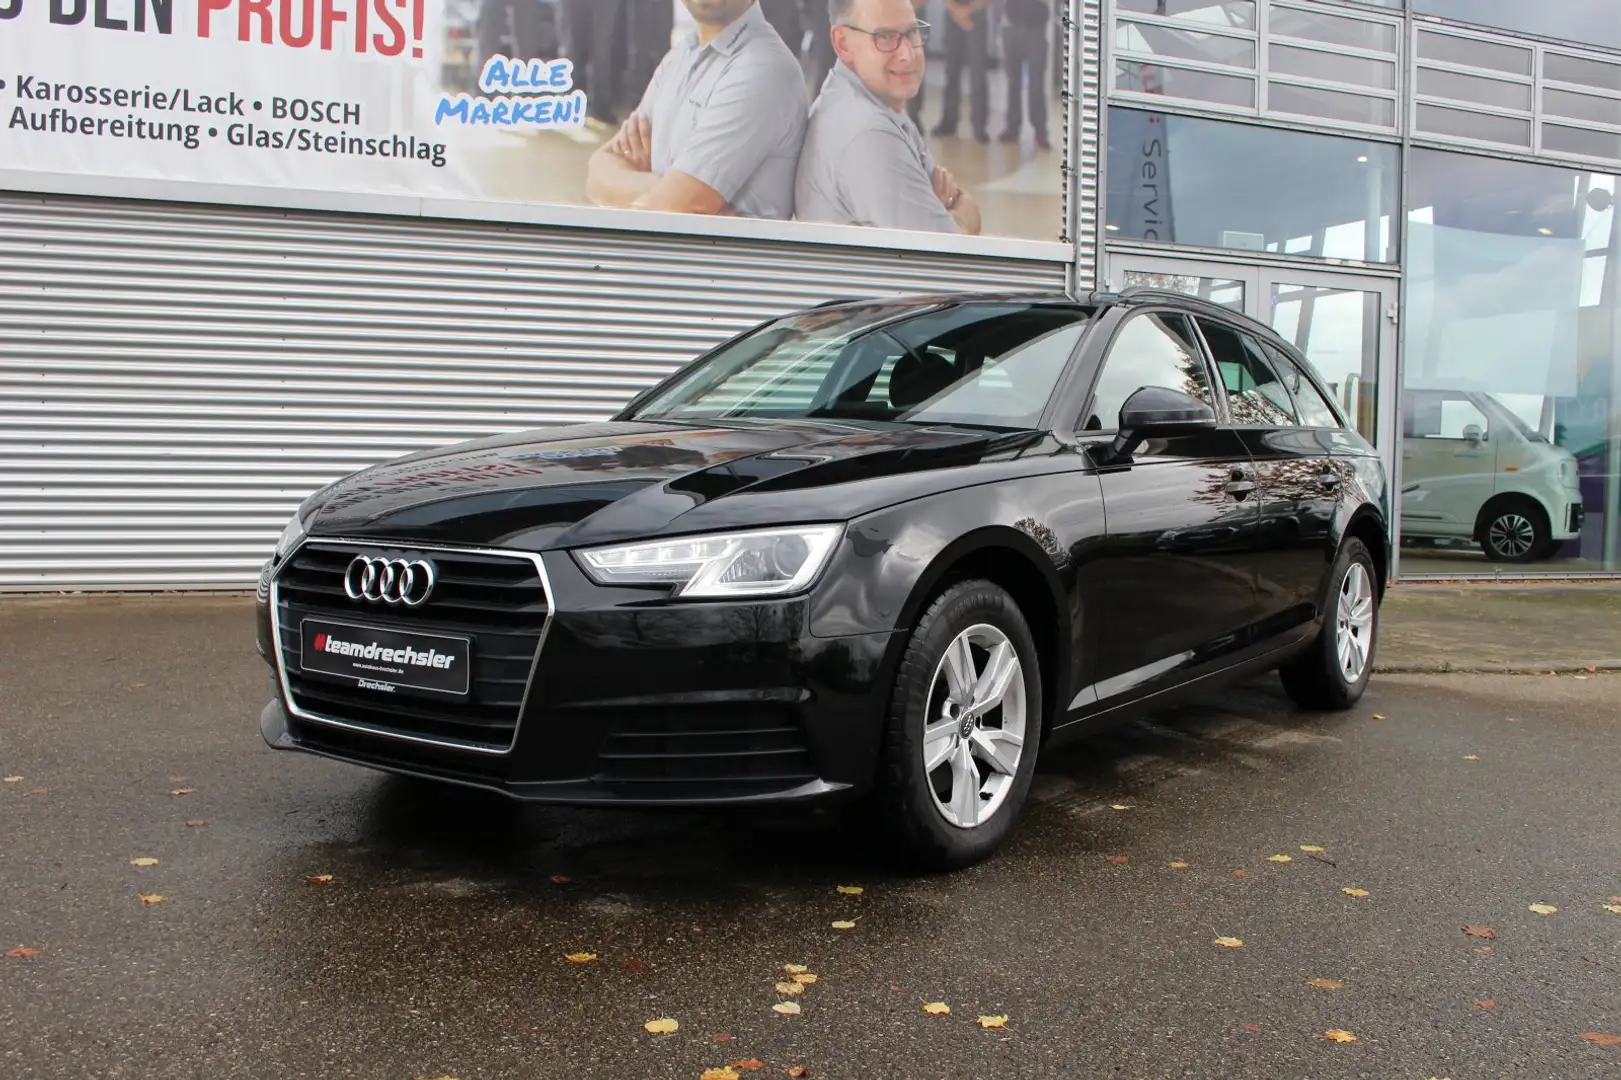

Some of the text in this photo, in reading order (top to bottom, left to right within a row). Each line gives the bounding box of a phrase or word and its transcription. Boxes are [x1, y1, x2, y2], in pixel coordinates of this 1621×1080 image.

[197, 0, 424, 58] PROFIS!
[485, 60, 568, 87] ALLE
[17, 75, 360, 125] Karosserie/Lack BOSCH
[435, 96, 582, 126] MARKEN!
[9, 106, 447, 167] Aufbereitung Glas/Steinschlag
[314, 633, 455, 669] #teamdrechsler
